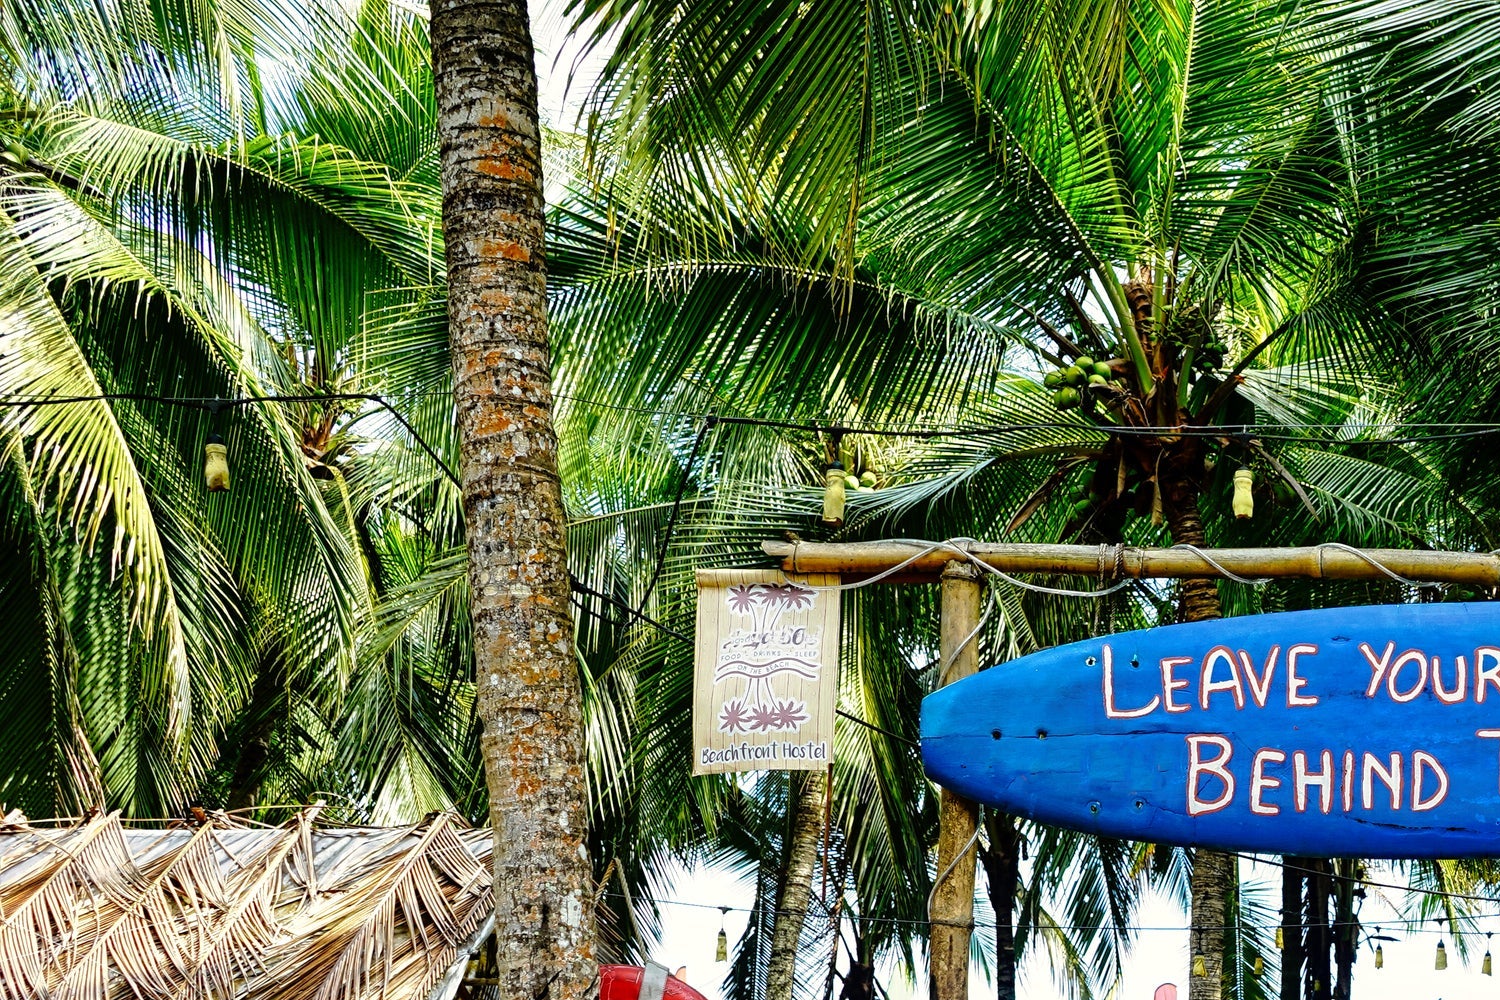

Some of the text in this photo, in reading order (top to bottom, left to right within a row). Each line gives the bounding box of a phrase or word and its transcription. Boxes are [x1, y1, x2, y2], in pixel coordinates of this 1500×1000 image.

[720, 652, 742, 662] FOOD
[1100, 642, 1319, 721] LEAVE
[702, 741, 826, 764] Beachfront Hostel
[1186, 733, 1449, 816] BEHIND
